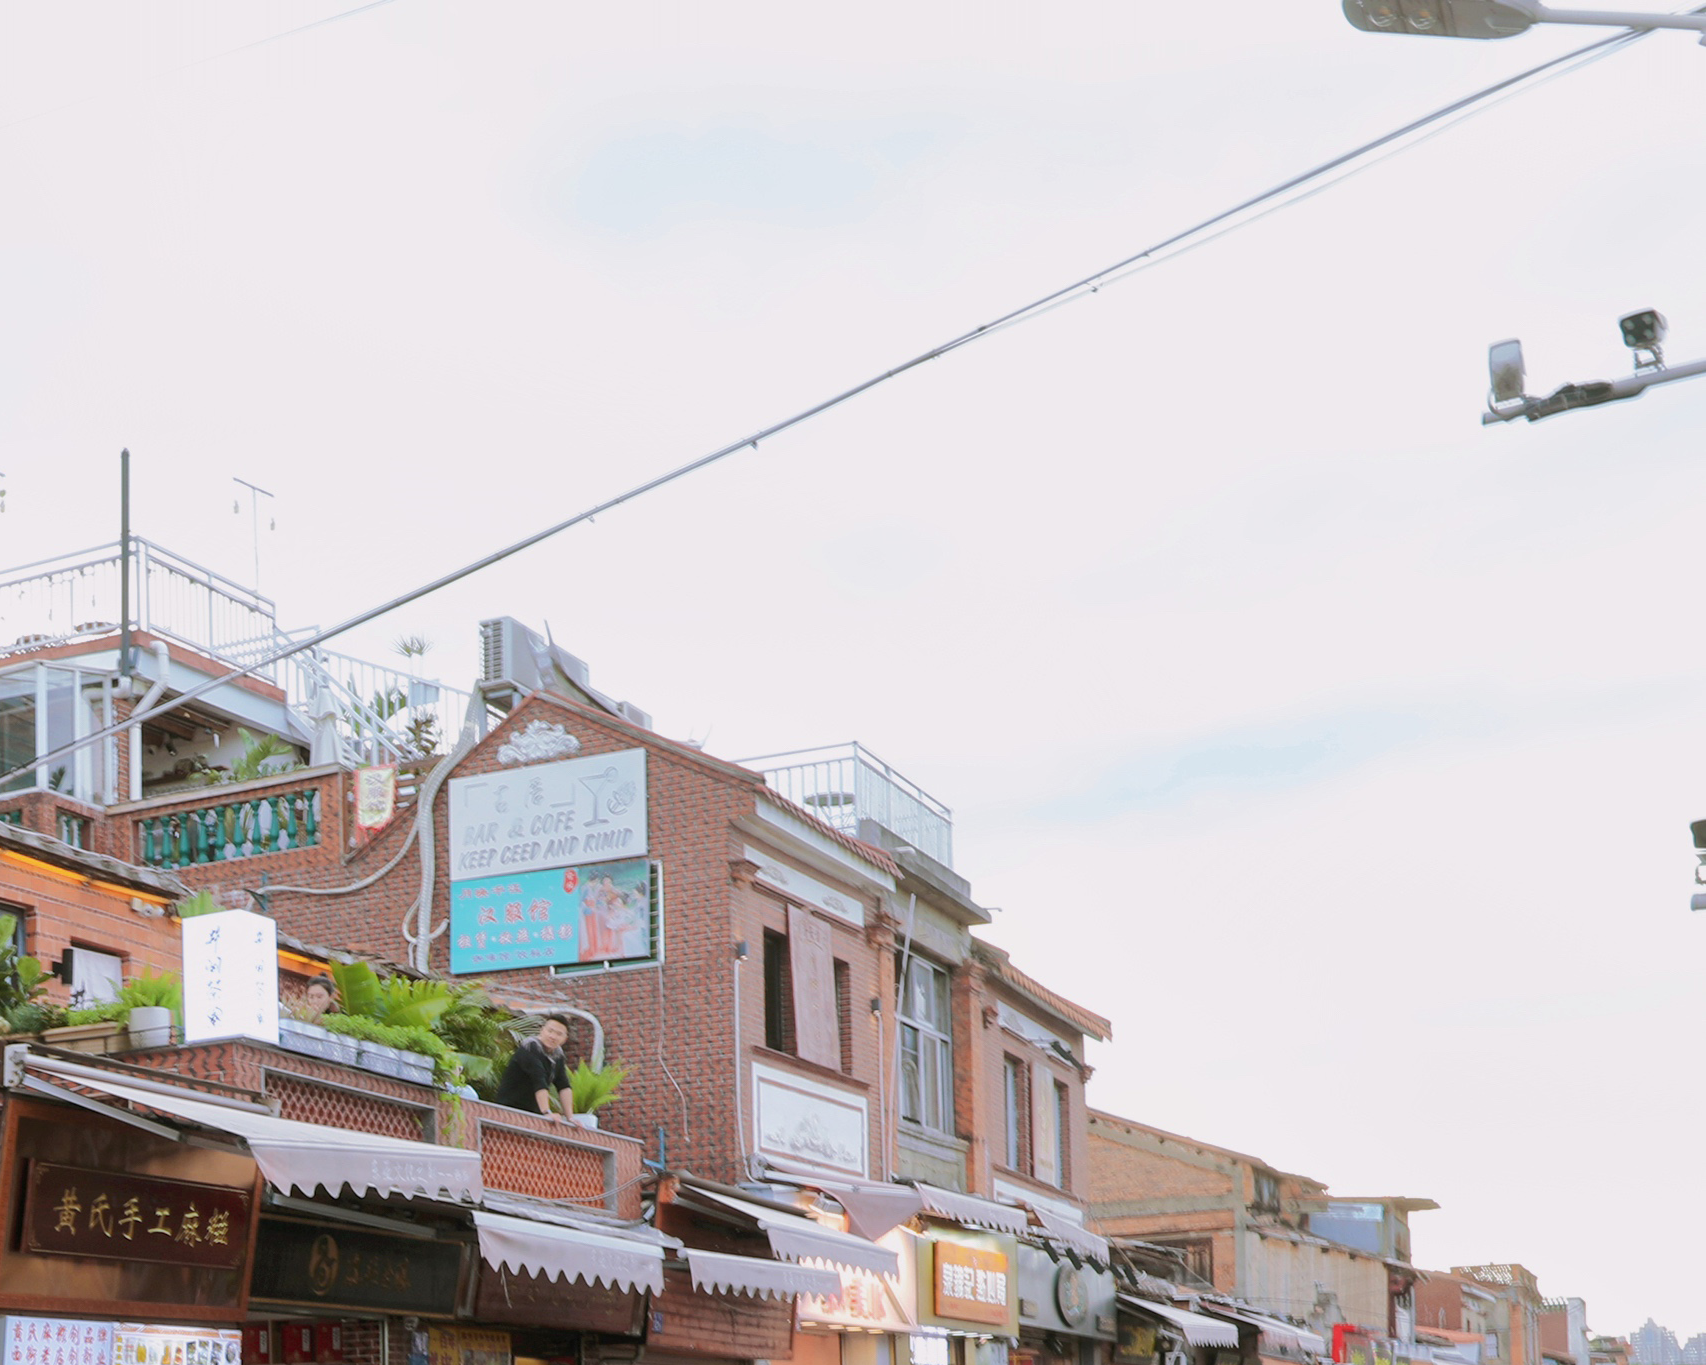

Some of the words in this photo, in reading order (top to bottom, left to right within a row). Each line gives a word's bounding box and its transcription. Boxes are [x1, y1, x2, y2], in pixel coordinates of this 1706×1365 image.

[463, 822, 499, 846] BAR
[458, 849, 498, 871] KEEP
[544, 835, 580, 860] AND
[478, 899, 552, 925] 汉服馆
